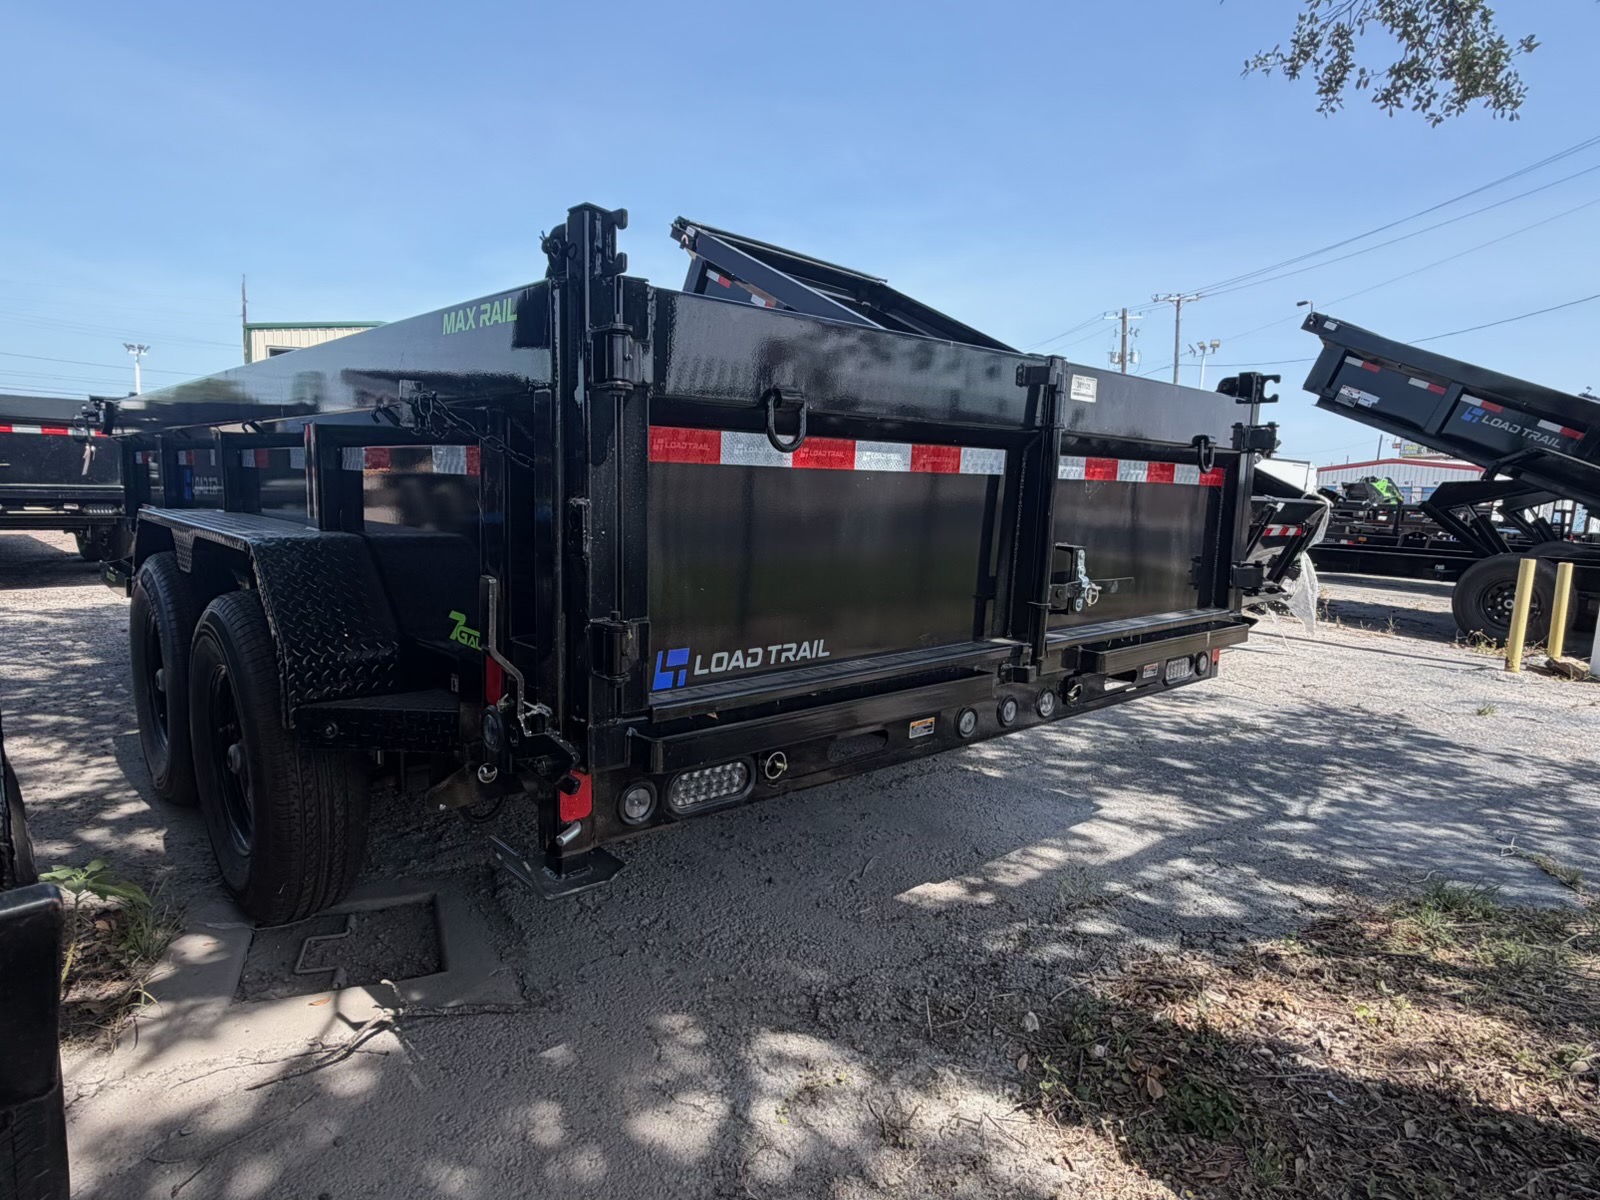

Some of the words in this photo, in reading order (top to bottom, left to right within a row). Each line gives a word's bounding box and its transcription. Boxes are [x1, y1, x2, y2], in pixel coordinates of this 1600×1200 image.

[443, 306, 476, 335] MAX
[480, 298, 517, 327] RAIL
[688, 442, 710, 451] TRAIL
[1481, 415, 1520, 434] LOAD
[1521, 428, 1561, 449] TRAIL
[693, 647, 764, 676] LOAD
[767, 639, 831, 665] TRAIL
